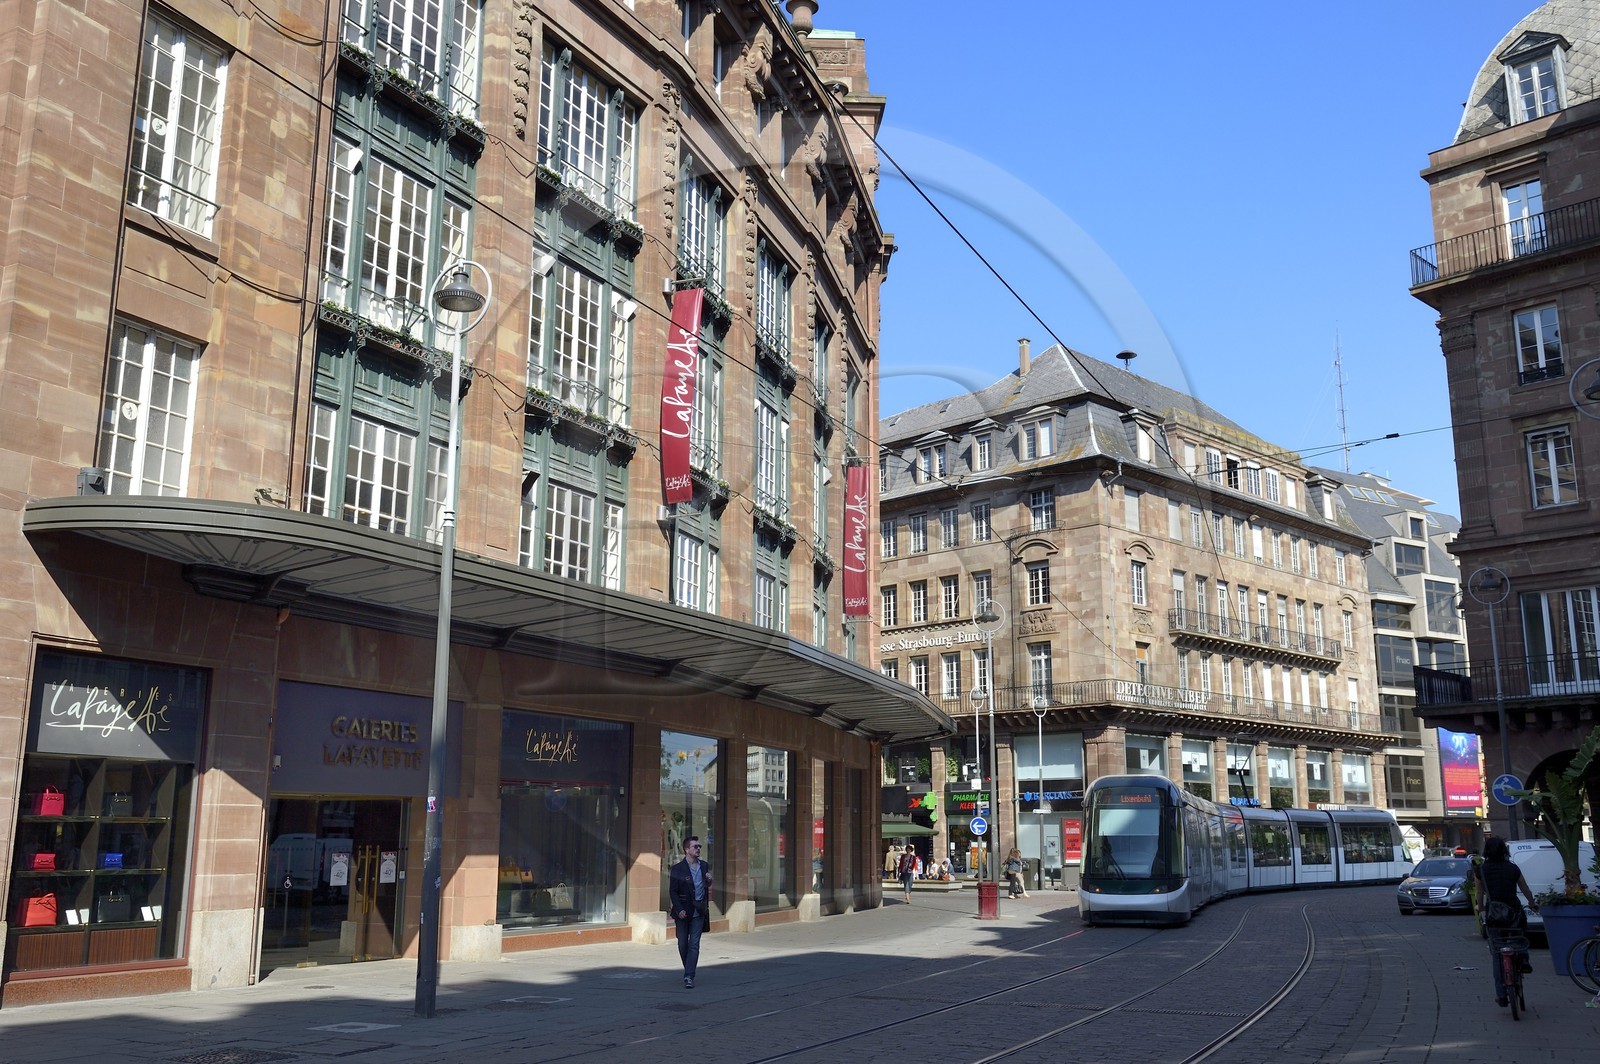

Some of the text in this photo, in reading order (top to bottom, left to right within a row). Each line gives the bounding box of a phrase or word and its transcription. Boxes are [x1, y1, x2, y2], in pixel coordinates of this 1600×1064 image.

[661, 323, 699, 438] Lafayette
[844, 491, 868, 573] Lafayette
[880, 642, 896, 653] sse
[1395, 655, 1411, 665] fnac
[51, 681, 173, 702] GALERIES
[1116, 680, 1174, 700] DETECTIVE
[1177, 688, 1209, 705] NIBEL
[47, 679, 172, 738] Lafayette
[330, 715, 419, 743] GALERIES
[322, 742, 424, 770] LAFAYETTE
[526, 728, 579, 767] Lafayette
[1406, 776, 1422, 786] fnac
[959, 801, 975, 810] KLEB
